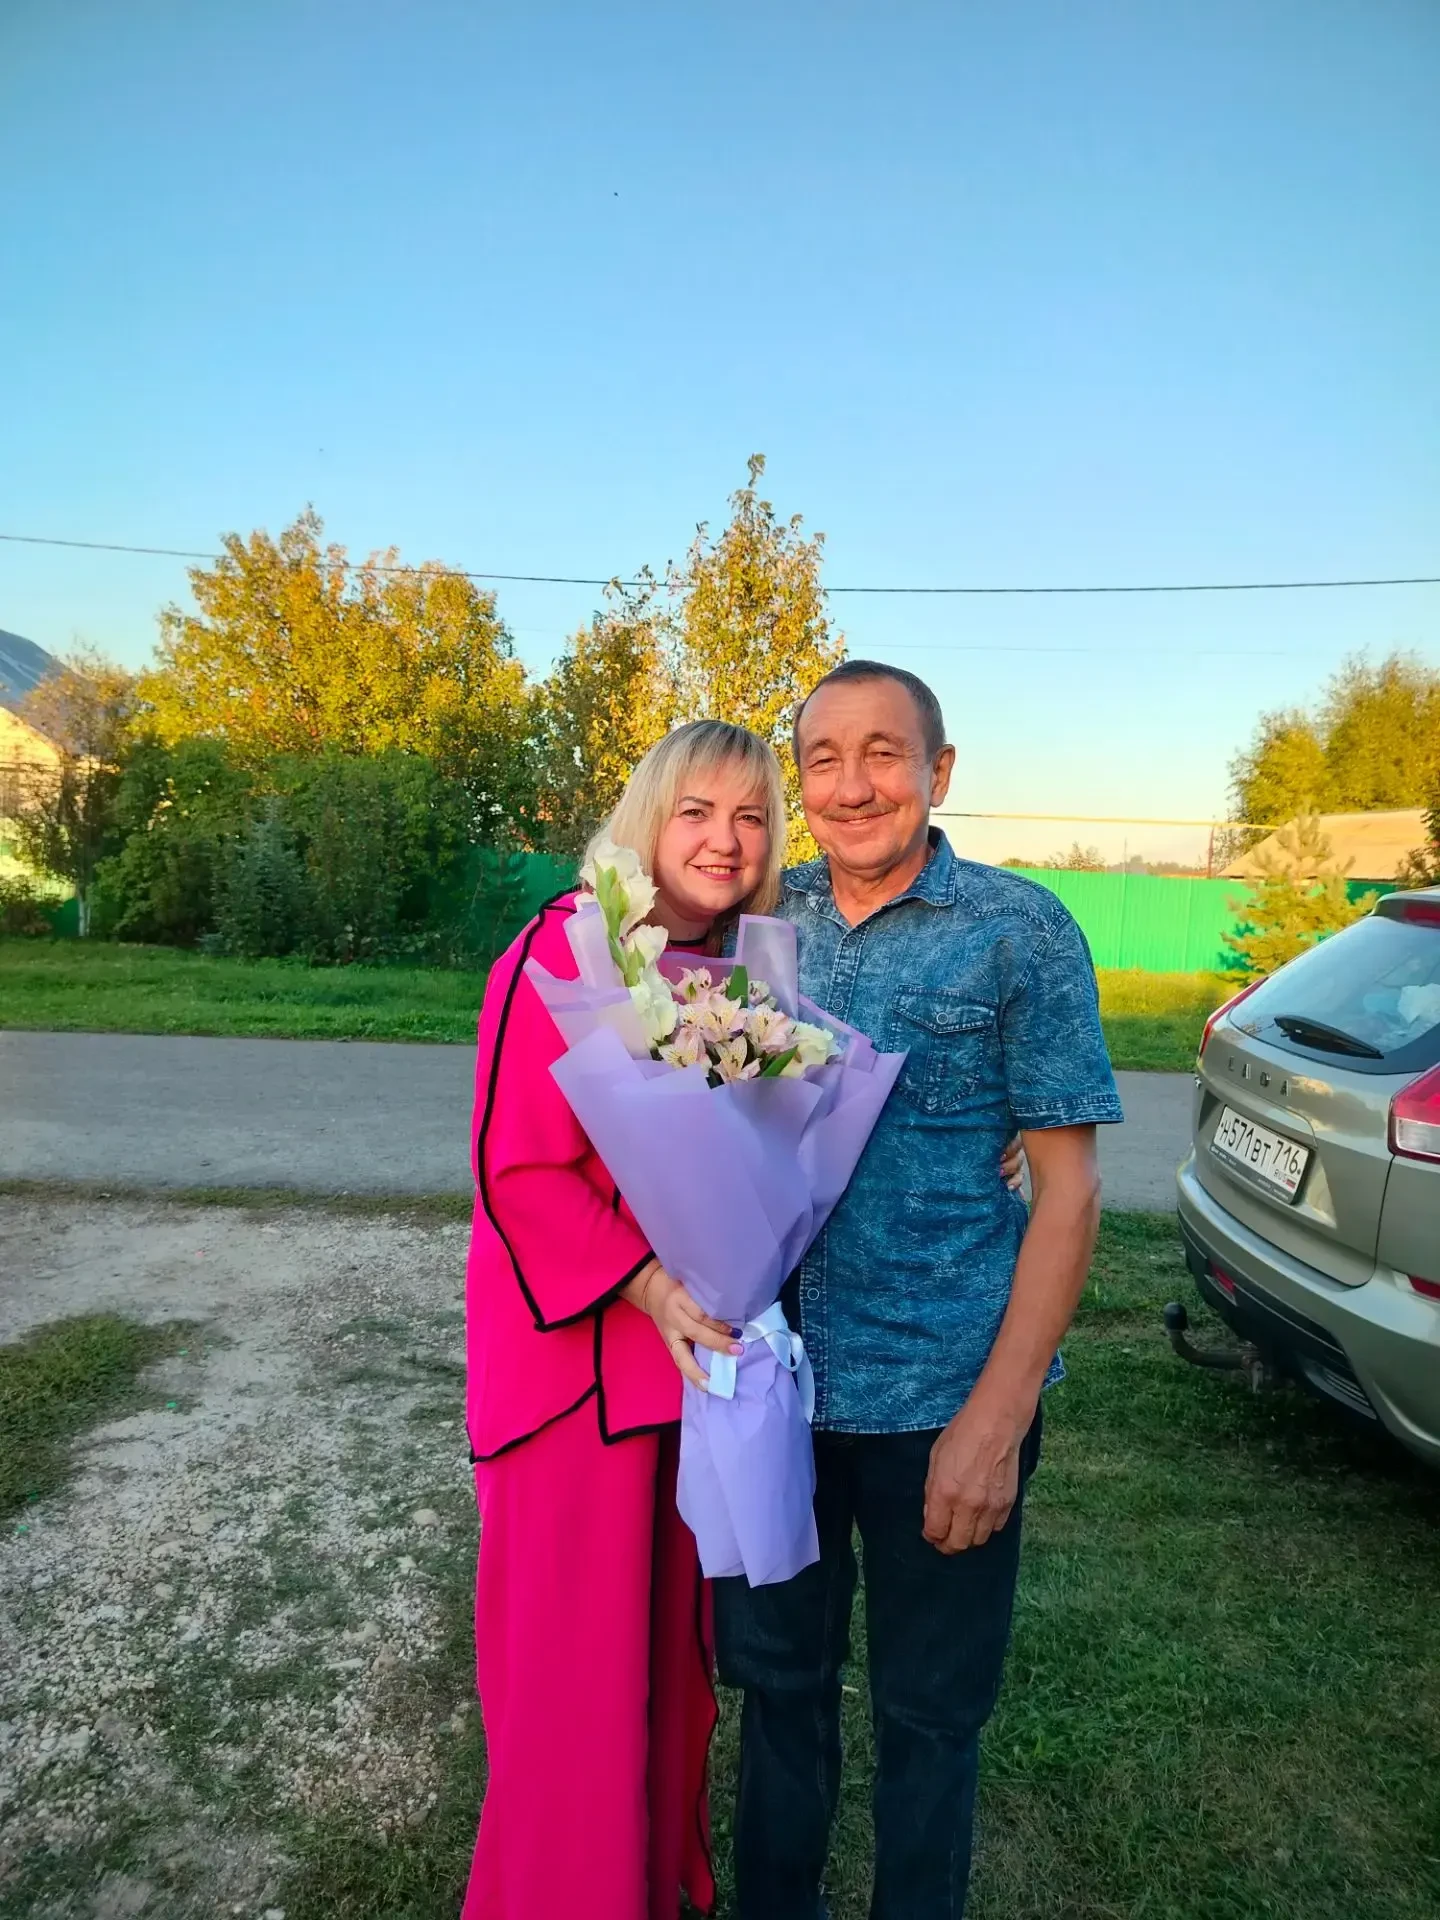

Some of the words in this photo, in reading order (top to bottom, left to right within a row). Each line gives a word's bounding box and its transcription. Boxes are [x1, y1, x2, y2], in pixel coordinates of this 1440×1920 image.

[1228, 1056, 1291, 1096] LADA
[1273, 1140, 1299, 1174] 716
[1273, 1168, 1287, 1184] RUS
